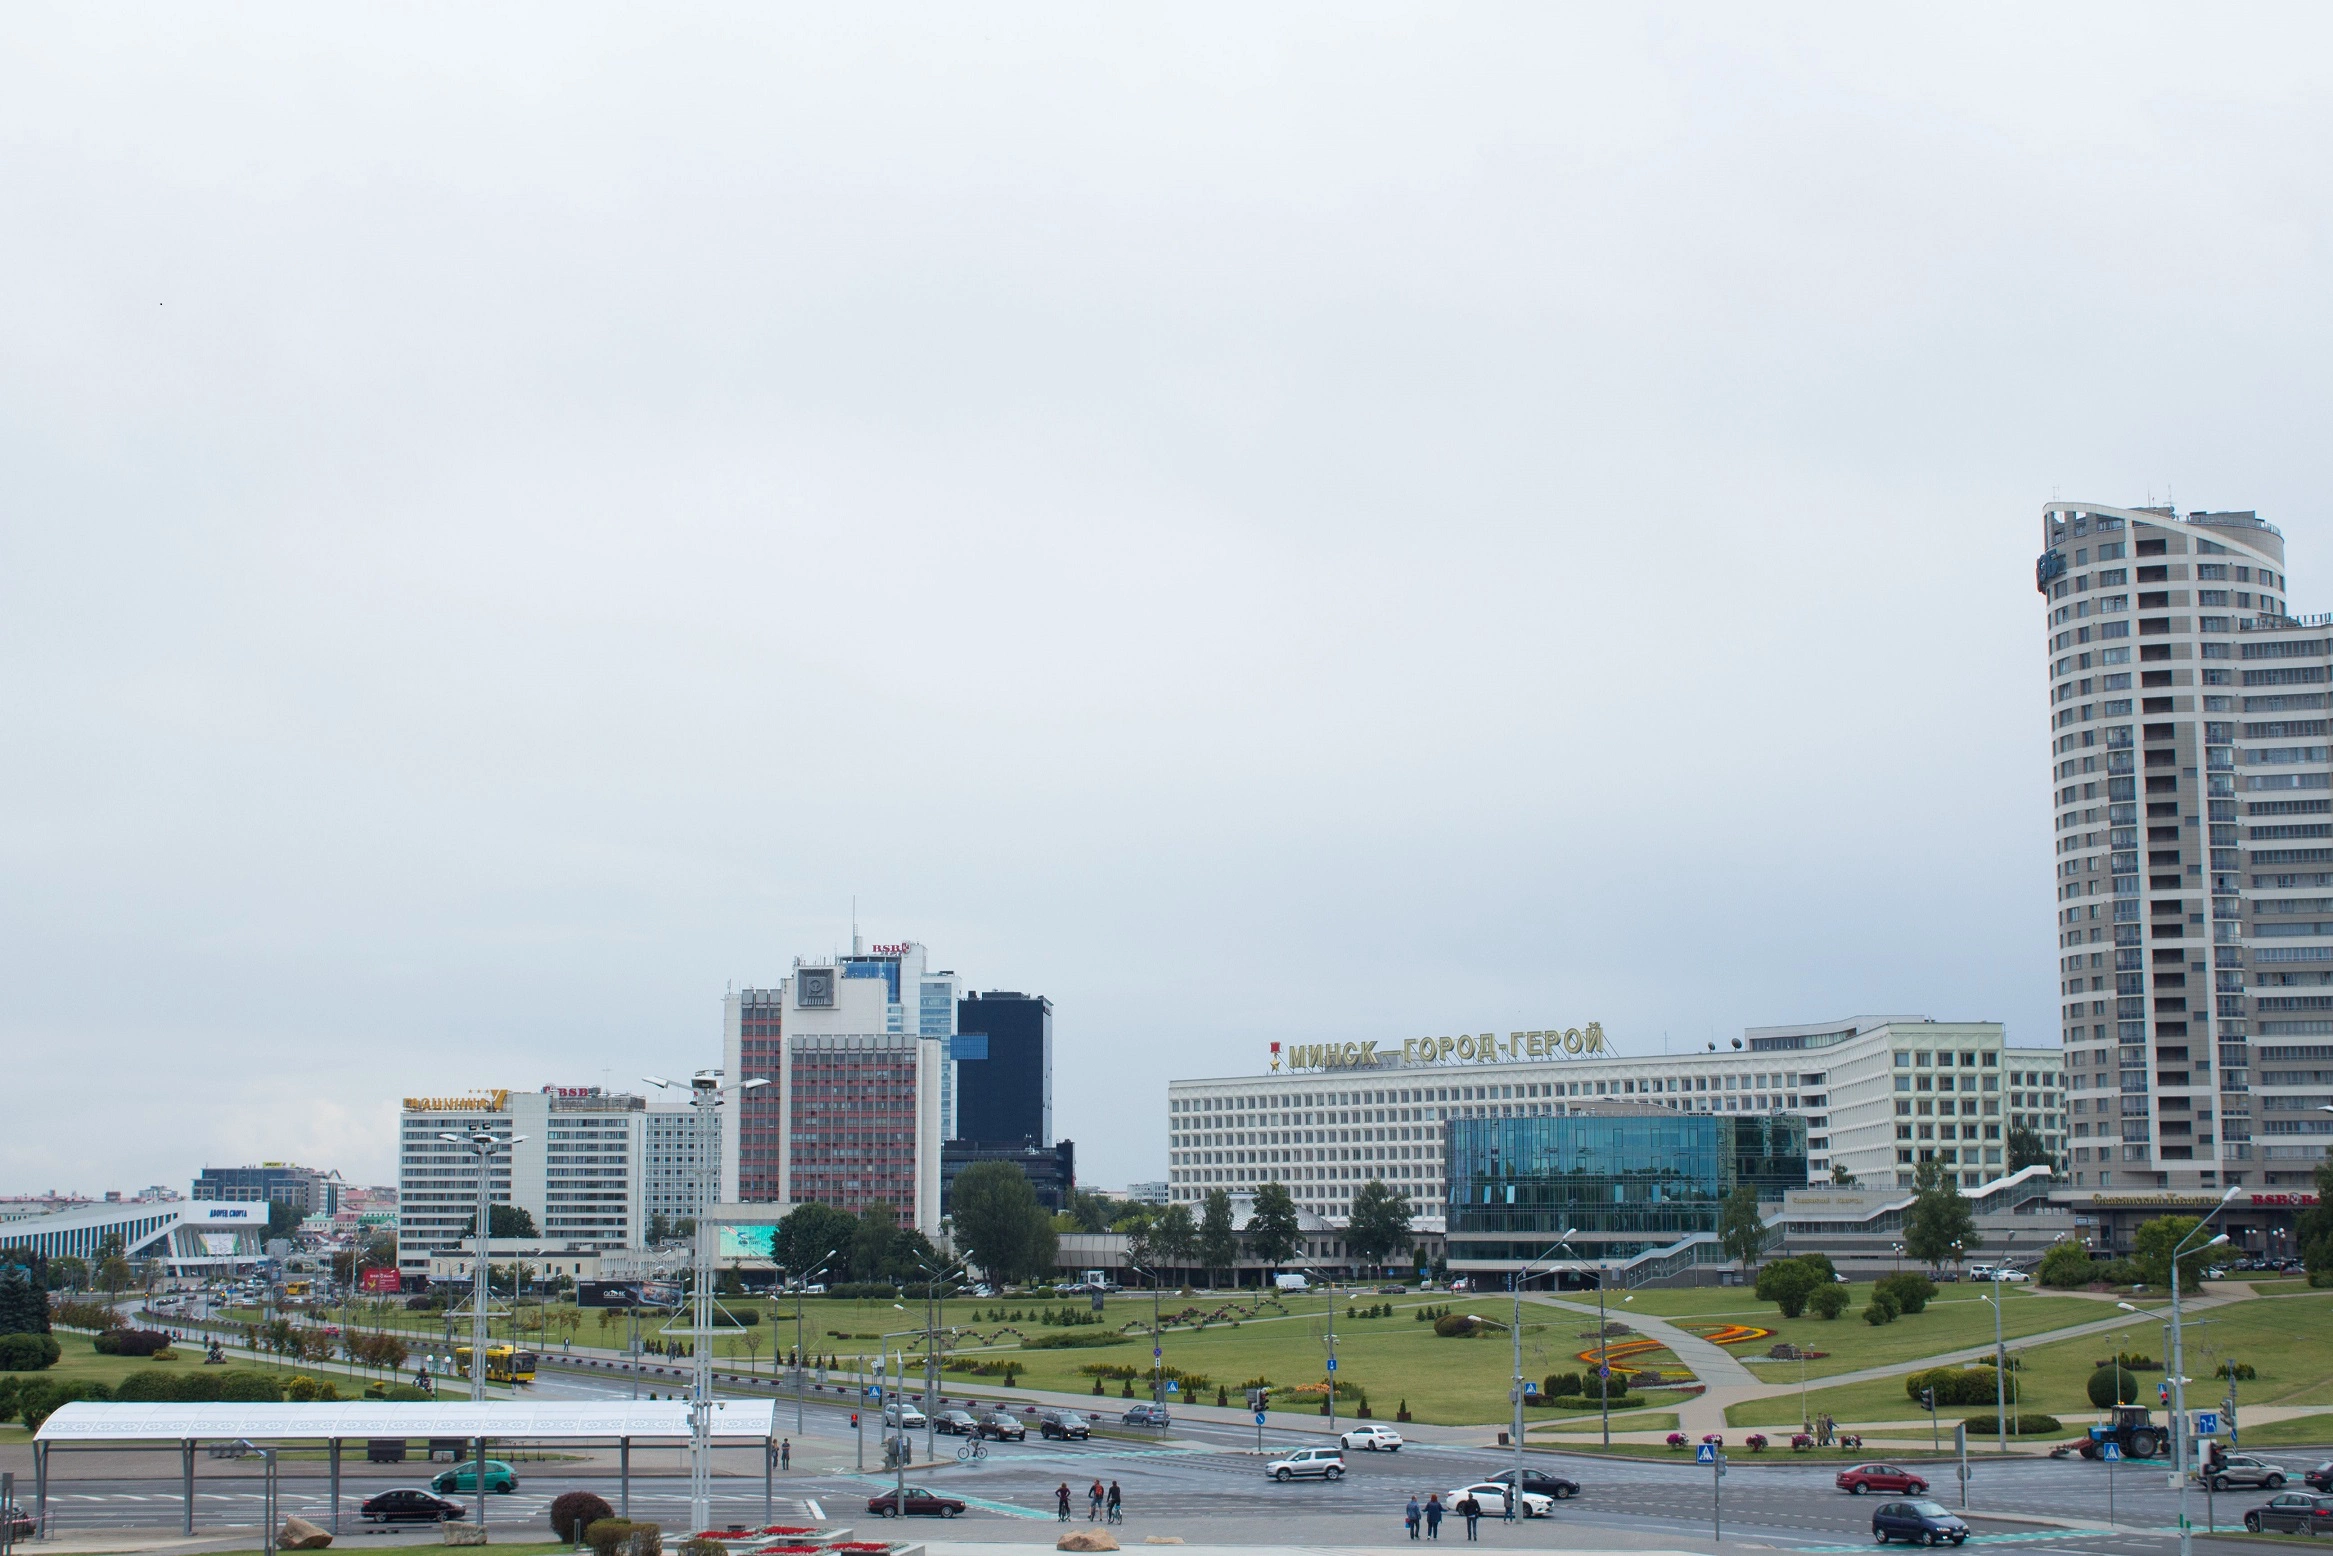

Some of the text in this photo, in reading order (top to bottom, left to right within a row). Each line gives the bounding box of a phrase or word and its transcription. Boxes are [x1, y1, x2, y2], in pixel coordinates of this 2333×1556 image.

[872, 944, 900, 953] BSB
[1289, 1040, 1379, 1069] МИНСК
[557, 1087, 589, 1097] BSB
[2250, 1194, 2288, 1205] BSB
